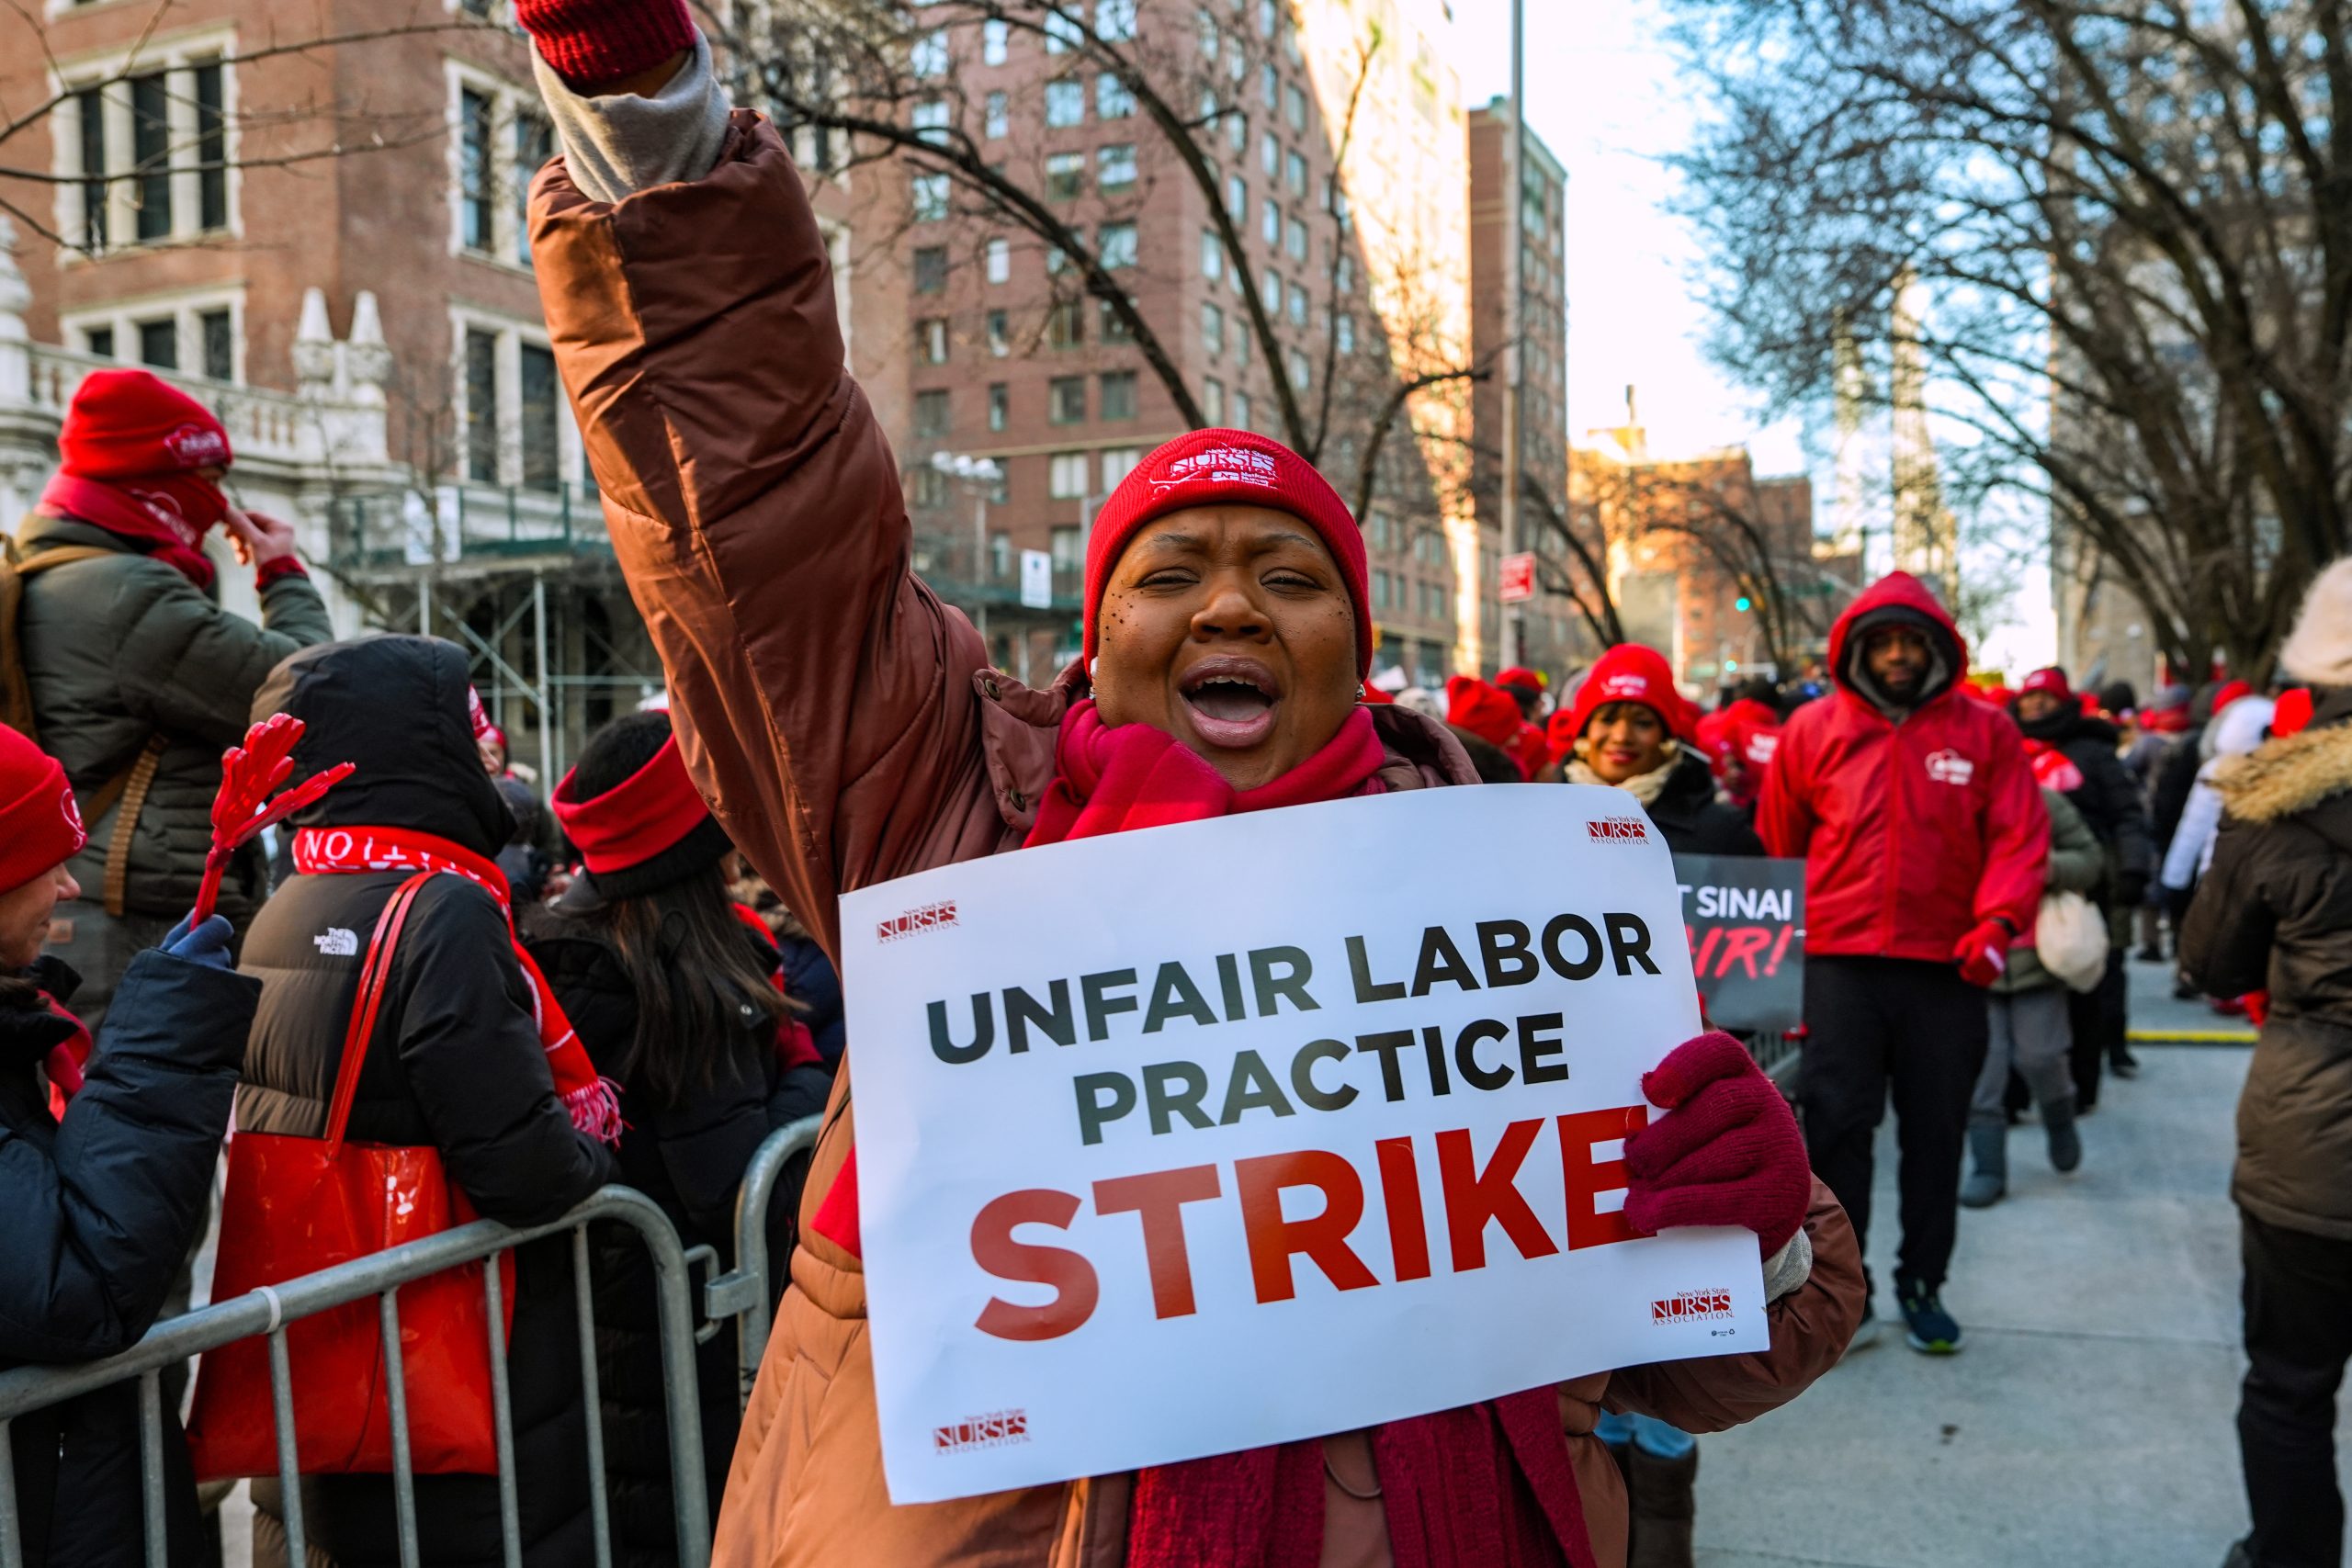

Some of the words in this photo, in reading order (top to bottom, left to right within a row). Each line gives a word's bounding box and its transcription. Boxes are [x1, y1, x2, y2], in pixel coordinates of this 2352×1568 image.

[1170, 453, 1275, 472] NURSES
[1587, 821, 1645, 838] NURSES
[1591, 837, 1649, 845] ASSOCIATION
[1696, 886, 1792, 920] SINAI
[877, 905, 956, 938] NURSES
[878, 919, 961, 944] ASSOCIATION
[927, 946, 1321, 1064] UNFAIR
[1345, 913, 1661, 1004] LABOR
[1073, 1012, 1569, 1145] PRACTICE
[970, 1104, 1657, 1341] STRIKE
[1694, 1288, 1710, 1296] York
[1651, 1295, 1731, 1319] NURSES
[1653, 1309, 1735, 1326] ASSOCIATION
[933, 1416, 1026, 1448] NURSES
